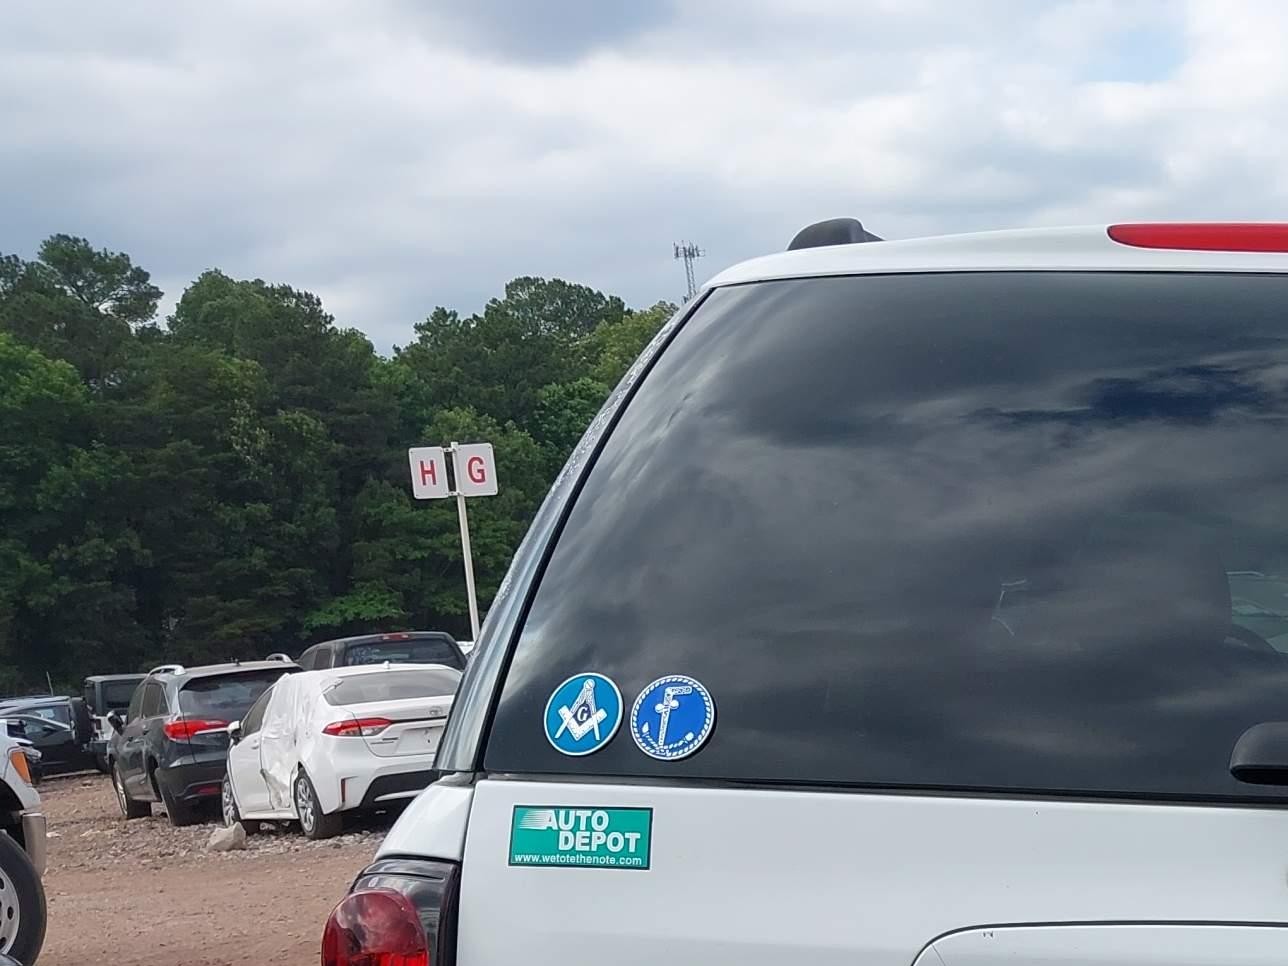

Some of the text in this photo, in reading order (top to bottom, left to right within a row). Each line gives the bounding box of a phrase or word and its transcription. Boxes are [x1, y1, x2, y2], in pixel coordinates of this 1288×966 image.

[420, 460, 437, 486] H
[467, 456, 486, 484] G
[576, 706, 588, 722] G
[520, 809, 609, 831] AUTO
[558, 831, 641, 853] DEPOT
[514, 854, 642, 866] www.wetotethenote.com
